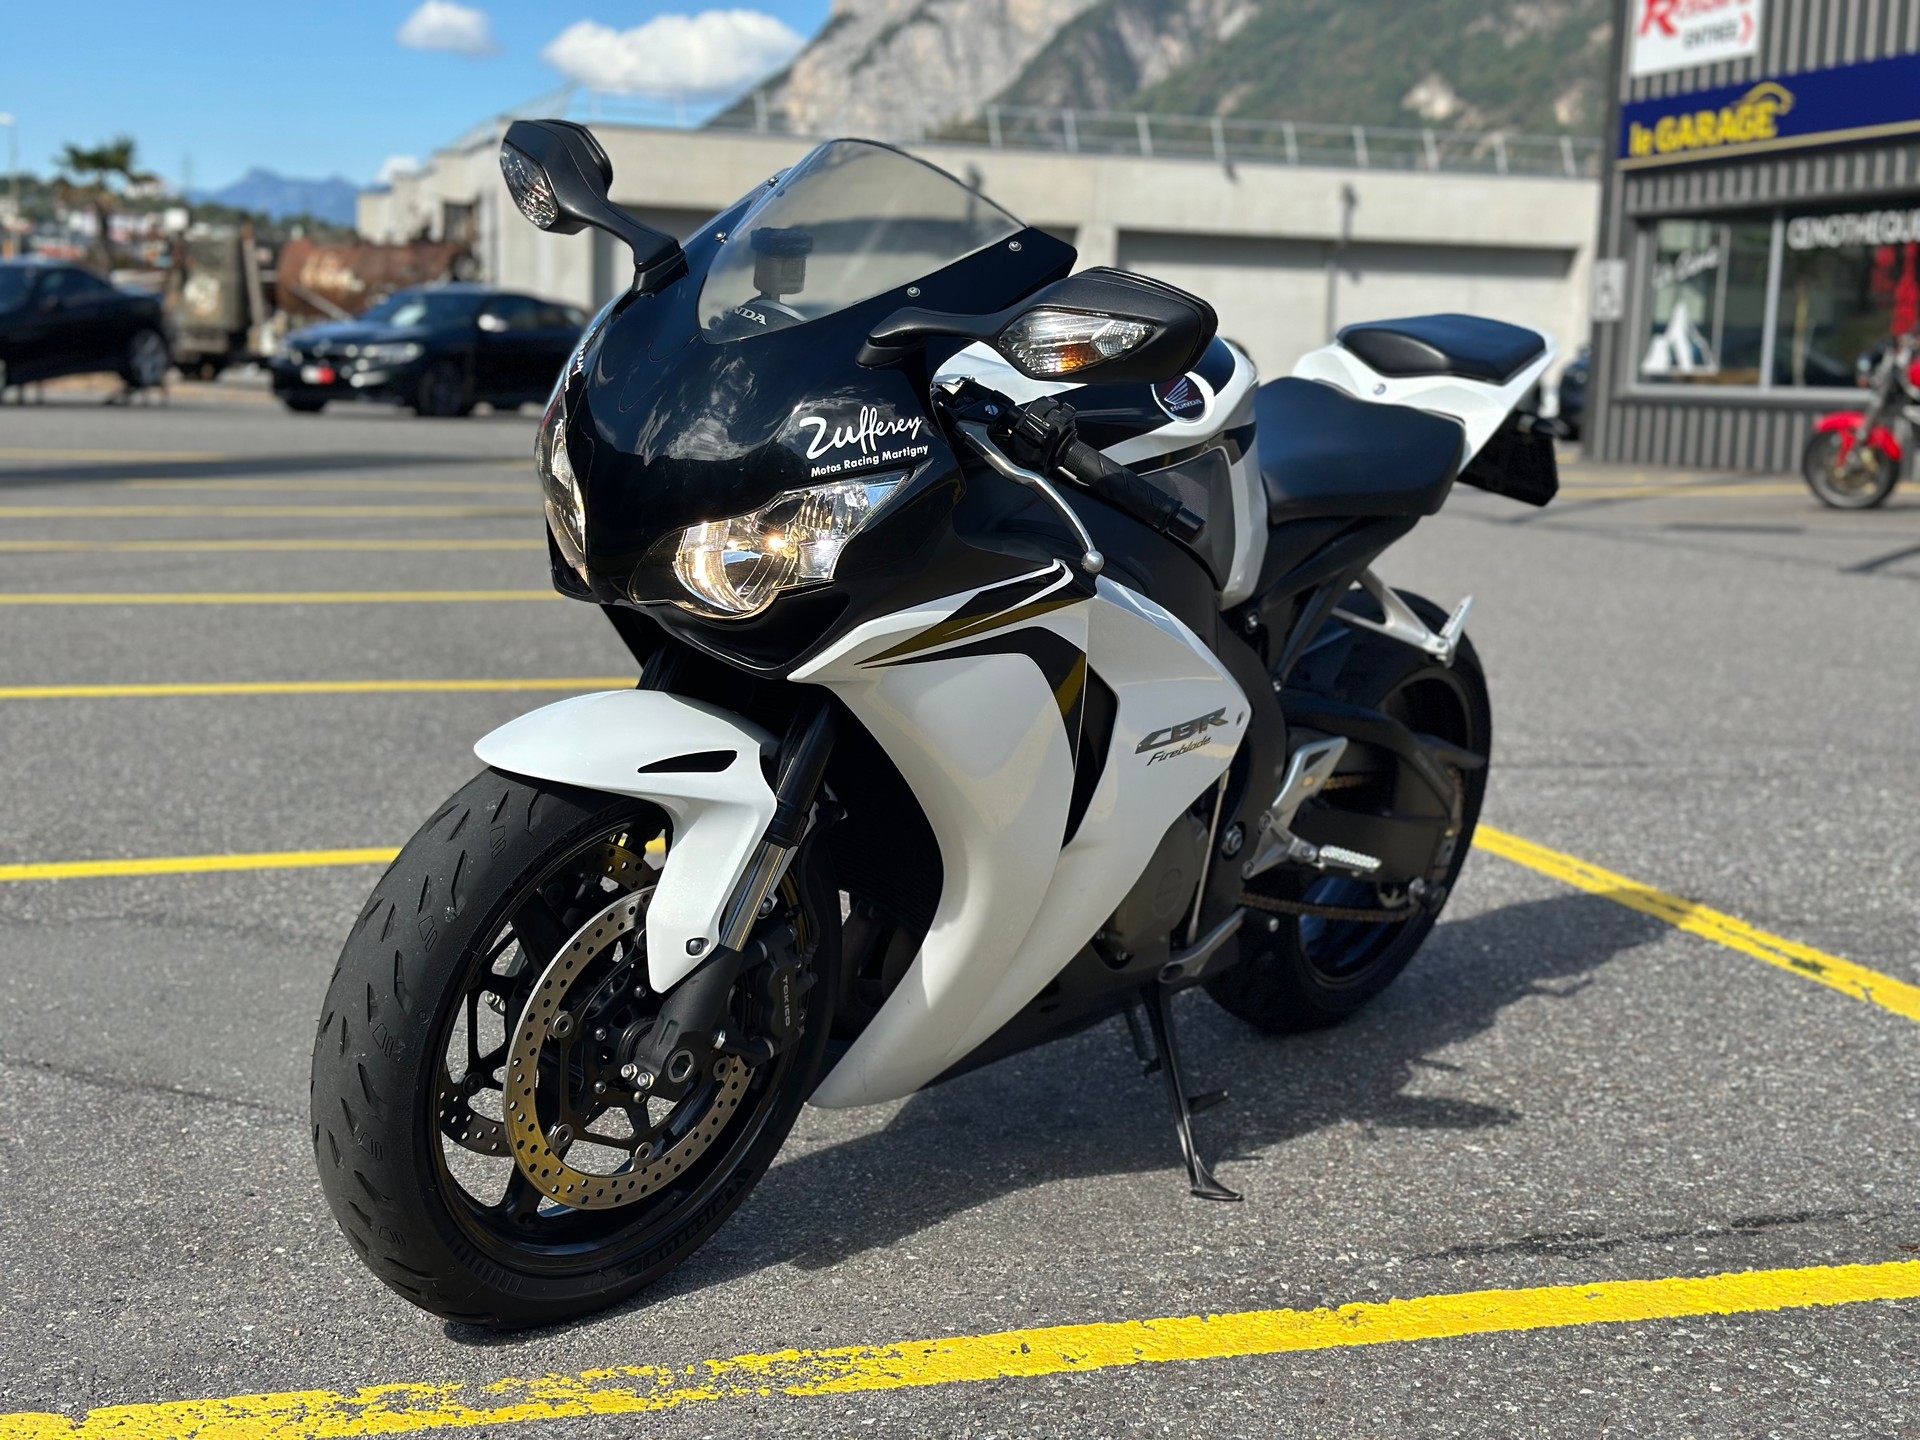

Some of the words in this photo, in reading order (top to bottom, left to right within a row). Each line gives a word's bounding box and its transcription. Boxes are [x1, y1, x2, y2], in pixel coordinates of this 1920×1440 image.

[1655, 101, 1778, 153] GARAGE
[734, 306, 766, 325] NDA
[1170, 399, 1203, 412] HONDA
[799, 406, 922, 460] Zufferey
[811, 463, 841, 477] Motos
[844, 455, 879, 469] Racing
[882, 445, 928, 462] Martigny
[1135, 707, 1228, 754] CBR
[1147, 735, 1211, 766] Fireblade
[782, 975, 791, 1027] TOKICO
